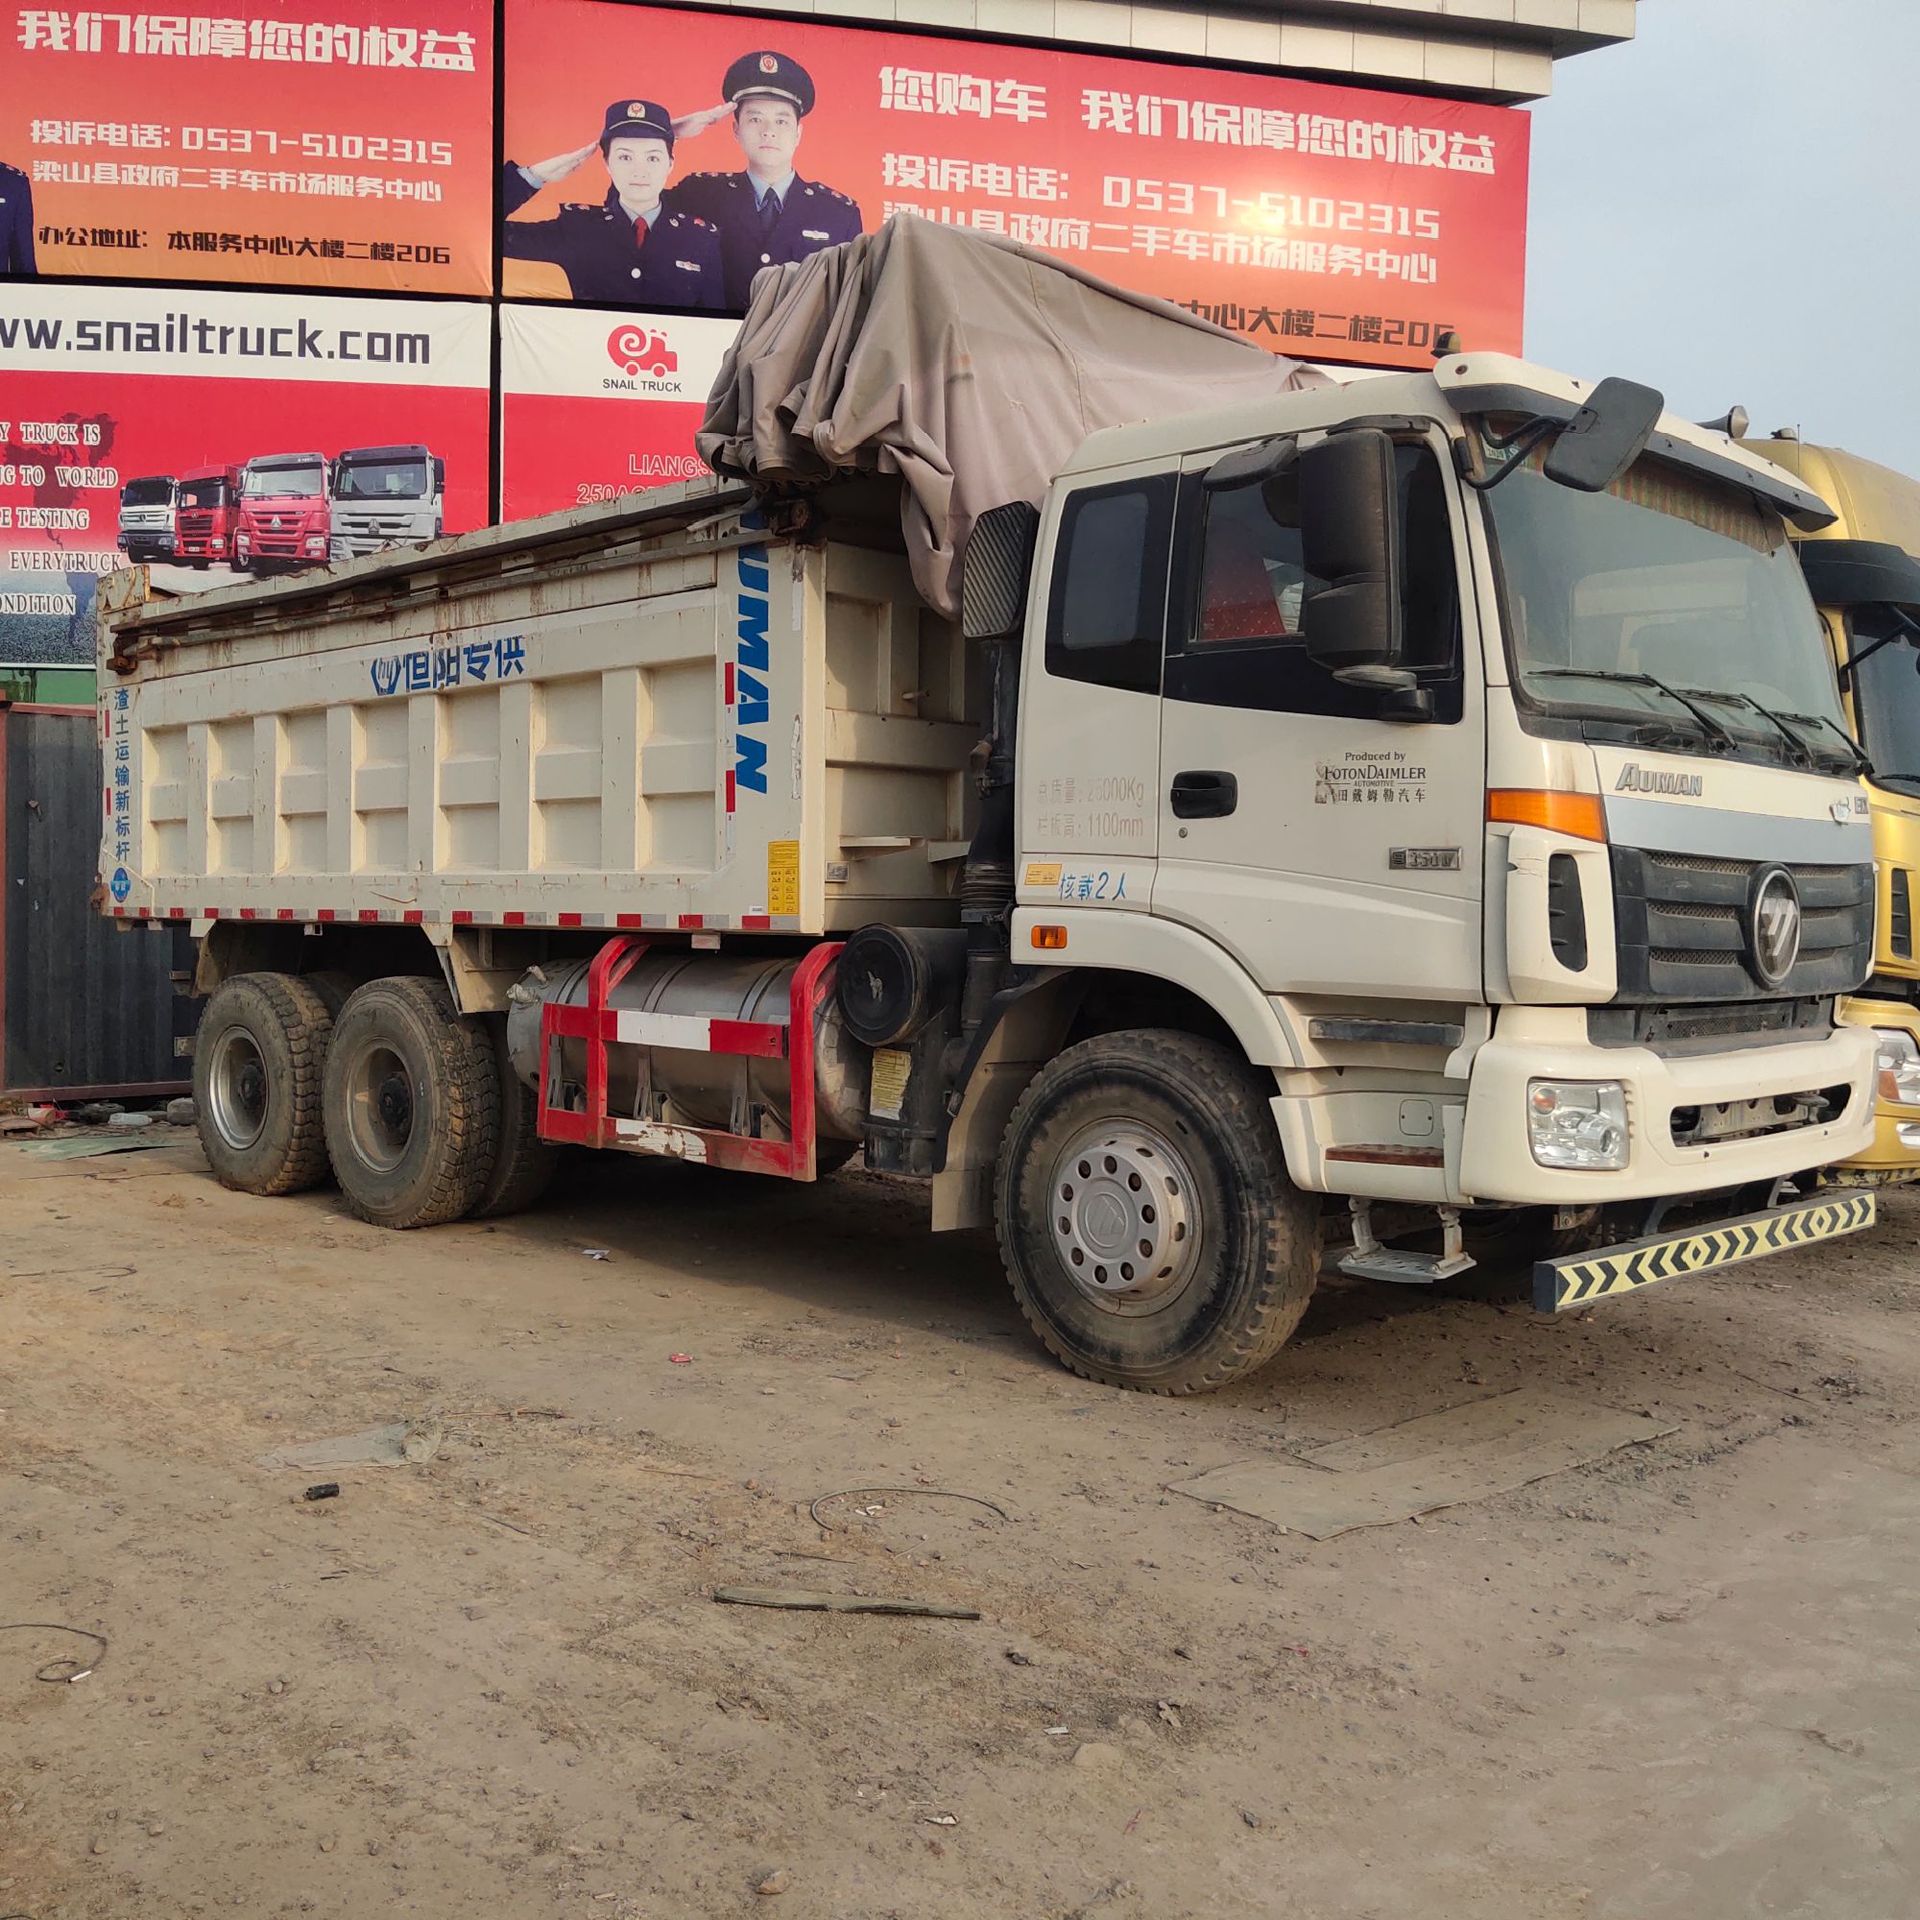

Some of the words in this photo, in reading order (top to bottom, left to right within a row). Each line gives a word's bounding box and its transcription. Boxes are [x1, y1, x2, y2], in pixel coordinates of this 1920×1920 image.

[16, 10, 476, 72] 我们保障您的权益
[878, 65, 1047, 124] 您购车
[1080, 88, 1497, 175] 我们保障您的权益
[181, 126, 453, 166] 0537-5102315
[33, 159, 442, 203] 梁山县政府二手车市场服务中心
[167, 230, 451, 265] 本服务中心大楼二楼206
[602, 378, 638, 391] SNAIL
[641, 380, 682, 393] TRUCK
[21, 423, 77, 442] TRUCK
[84, 424, 100, 443] IS
[0, 466, 14, 484] G
[21, 466, 44, 485] TO
[56, 467, 117, 488] WORLD
[628, 454, 713, 478] LIANGS
[17, 508, 89, 528] TESTING
[0, 594, 76, 615] NDITION
[1345, 751, 1391, 761] Produced
[1394, 751, 1406, 763] by
[114, 687, 131, 862] 渣土运输新标杆
[1354, 780, 1395, 788] AUTOMOTIVE
[1060, 871, 1127, 901] 核载2人
